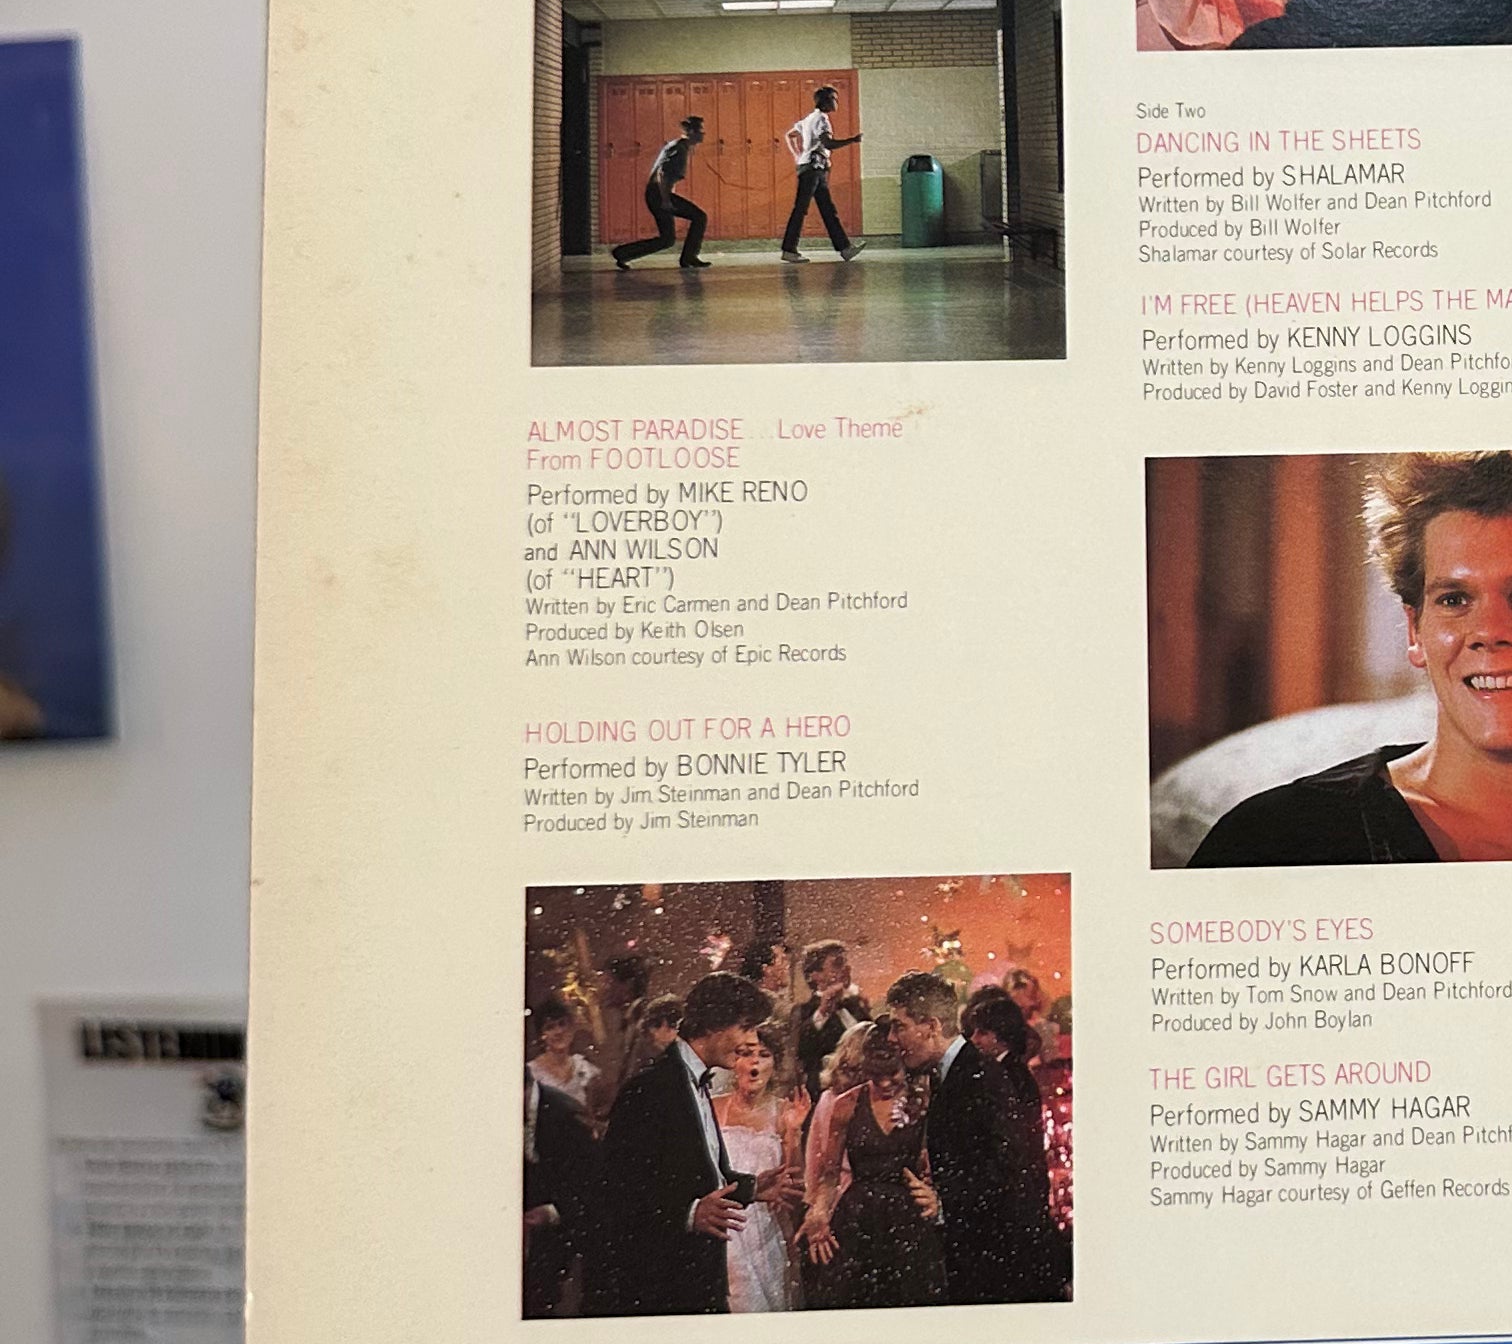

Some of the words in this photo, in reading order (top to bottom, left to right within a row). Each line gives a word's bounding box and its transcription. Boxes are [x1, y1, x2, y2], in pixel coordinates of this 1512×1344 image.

[1135, 102, 1169, 120] Side
[1174, 101, 1206, 119] Two
[1136, 130, 1240, 154] DANCING
[1249, 130, 1270, 152] IN
[1278, 129, 1324, 152] THE
[1332, 127, 1421, 152] SHEETS
[1138, 166, 1244, 189] Performed
[1252, 165, 1275, 191] by
[1281, 162, 1405, 187] SHALAMAR
[1141, 294, 1172, 316] I'M
[1181, 293, 1237, 316] FREE
[1245, 291, 1340, 318] (HEAVEN
[1351, 289, 1424, 313] HELPS
[1432, 288, 1478, 311] THE
[527, 419, 624, 443] ALMOST
[632, 417, 745, 441] PARADISE
[527, 448, 582, 471] From
[590, 445, 741, 470] FOOTLOOSE
[525, 719, 637, 745] HOLDING
[648, 718, 696, 742] OUT
[704, 717, 752, 741] FOR
[759, 716, 776, 739] A
[785, 714, 851, 738] HERO
[524, 756, 636, 780] Performed
[645, 756, 669, 782] by
[677, 752, 769, 777] BONNIE
[776, 750, 847, 774] TYLER
[1150, 918, 1307, 945] SOMEBODY'S
[1316, 917, 1374, 941] EYES
[1151, 956, 1260, 981] Performed
[1269, 955, 1291, 982] by
[1300, 953, 1372, 977] KARLA
[1380, 951, 1475, 976] BONOFF
[1148, 1067, 1197, 1090] THE
[1205, 1065, 1257, 1090] GIRL
[1266, 1063, 1326, 1088] GETS
[1334, 1060, 1432, 1085] AROUND
